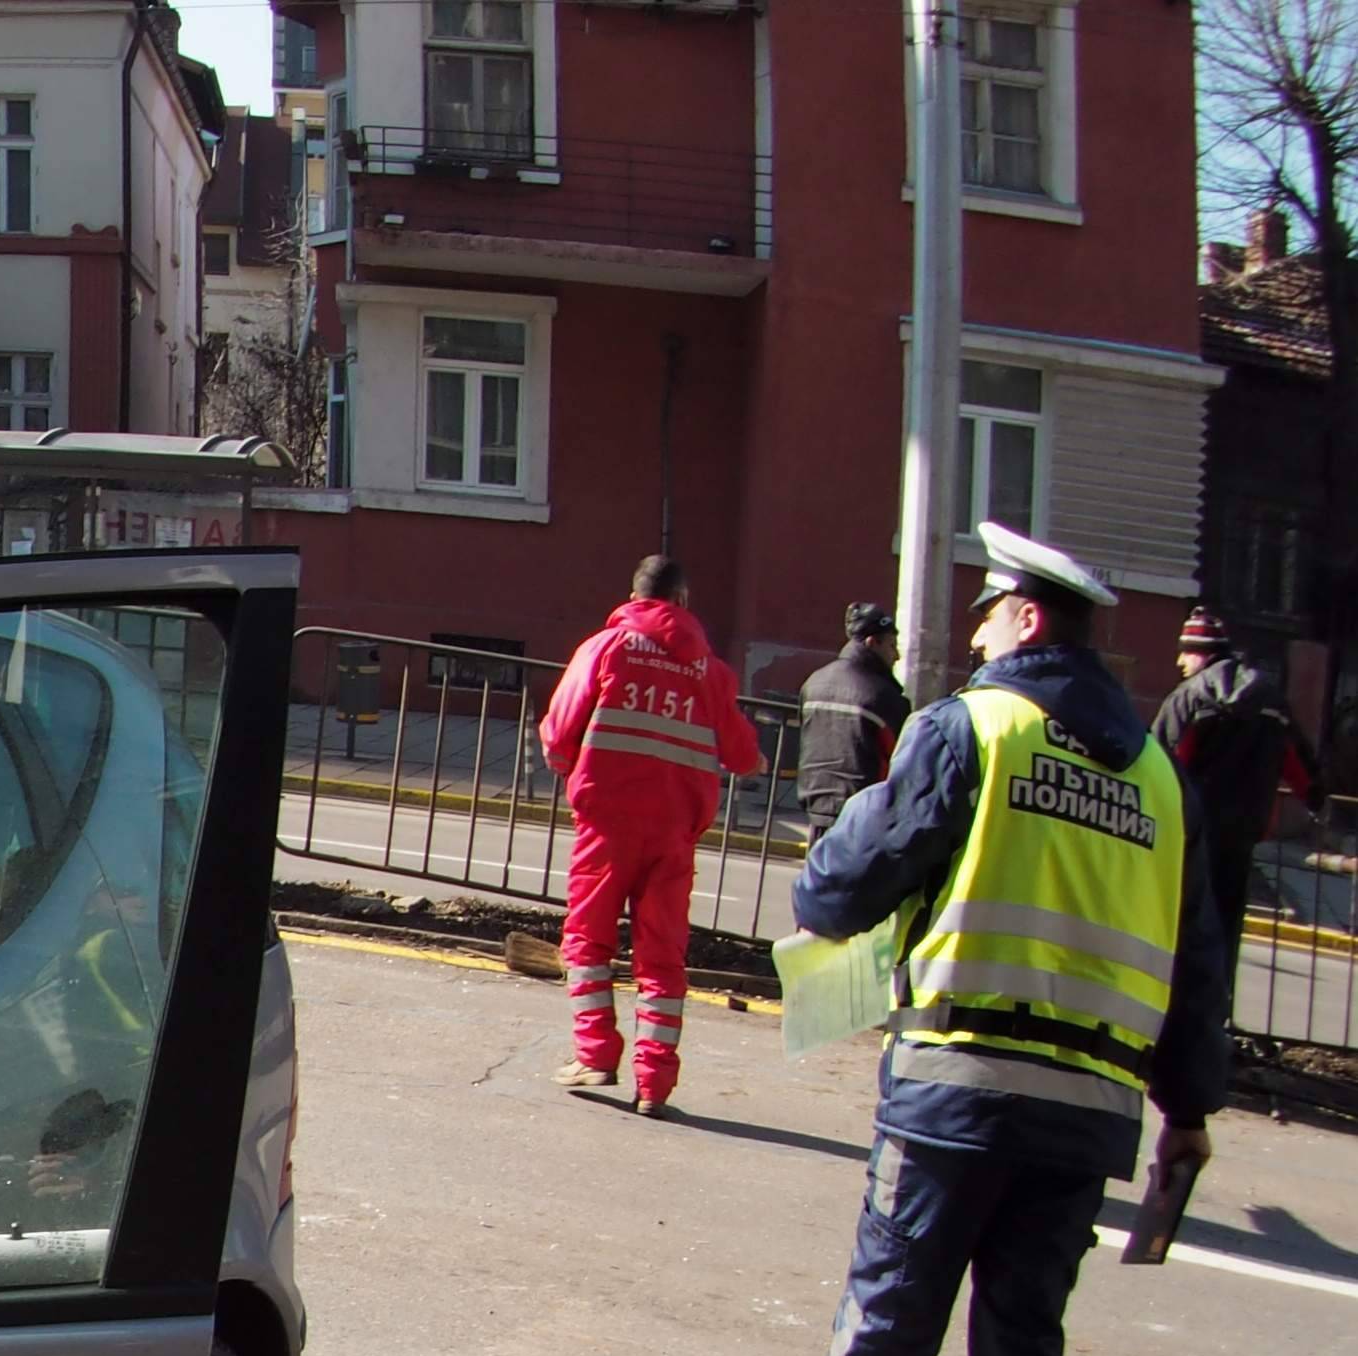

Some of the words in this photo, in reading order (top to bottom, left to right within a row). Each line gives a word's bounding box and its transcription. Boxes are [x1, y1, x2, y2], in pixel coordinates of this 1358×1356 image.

[622, 682, 695, 724] 3151
[1011, 778, 1155, 844] ПОЛИЦИЯ
[1035, 755, 1139, 811] ПЪТНА
